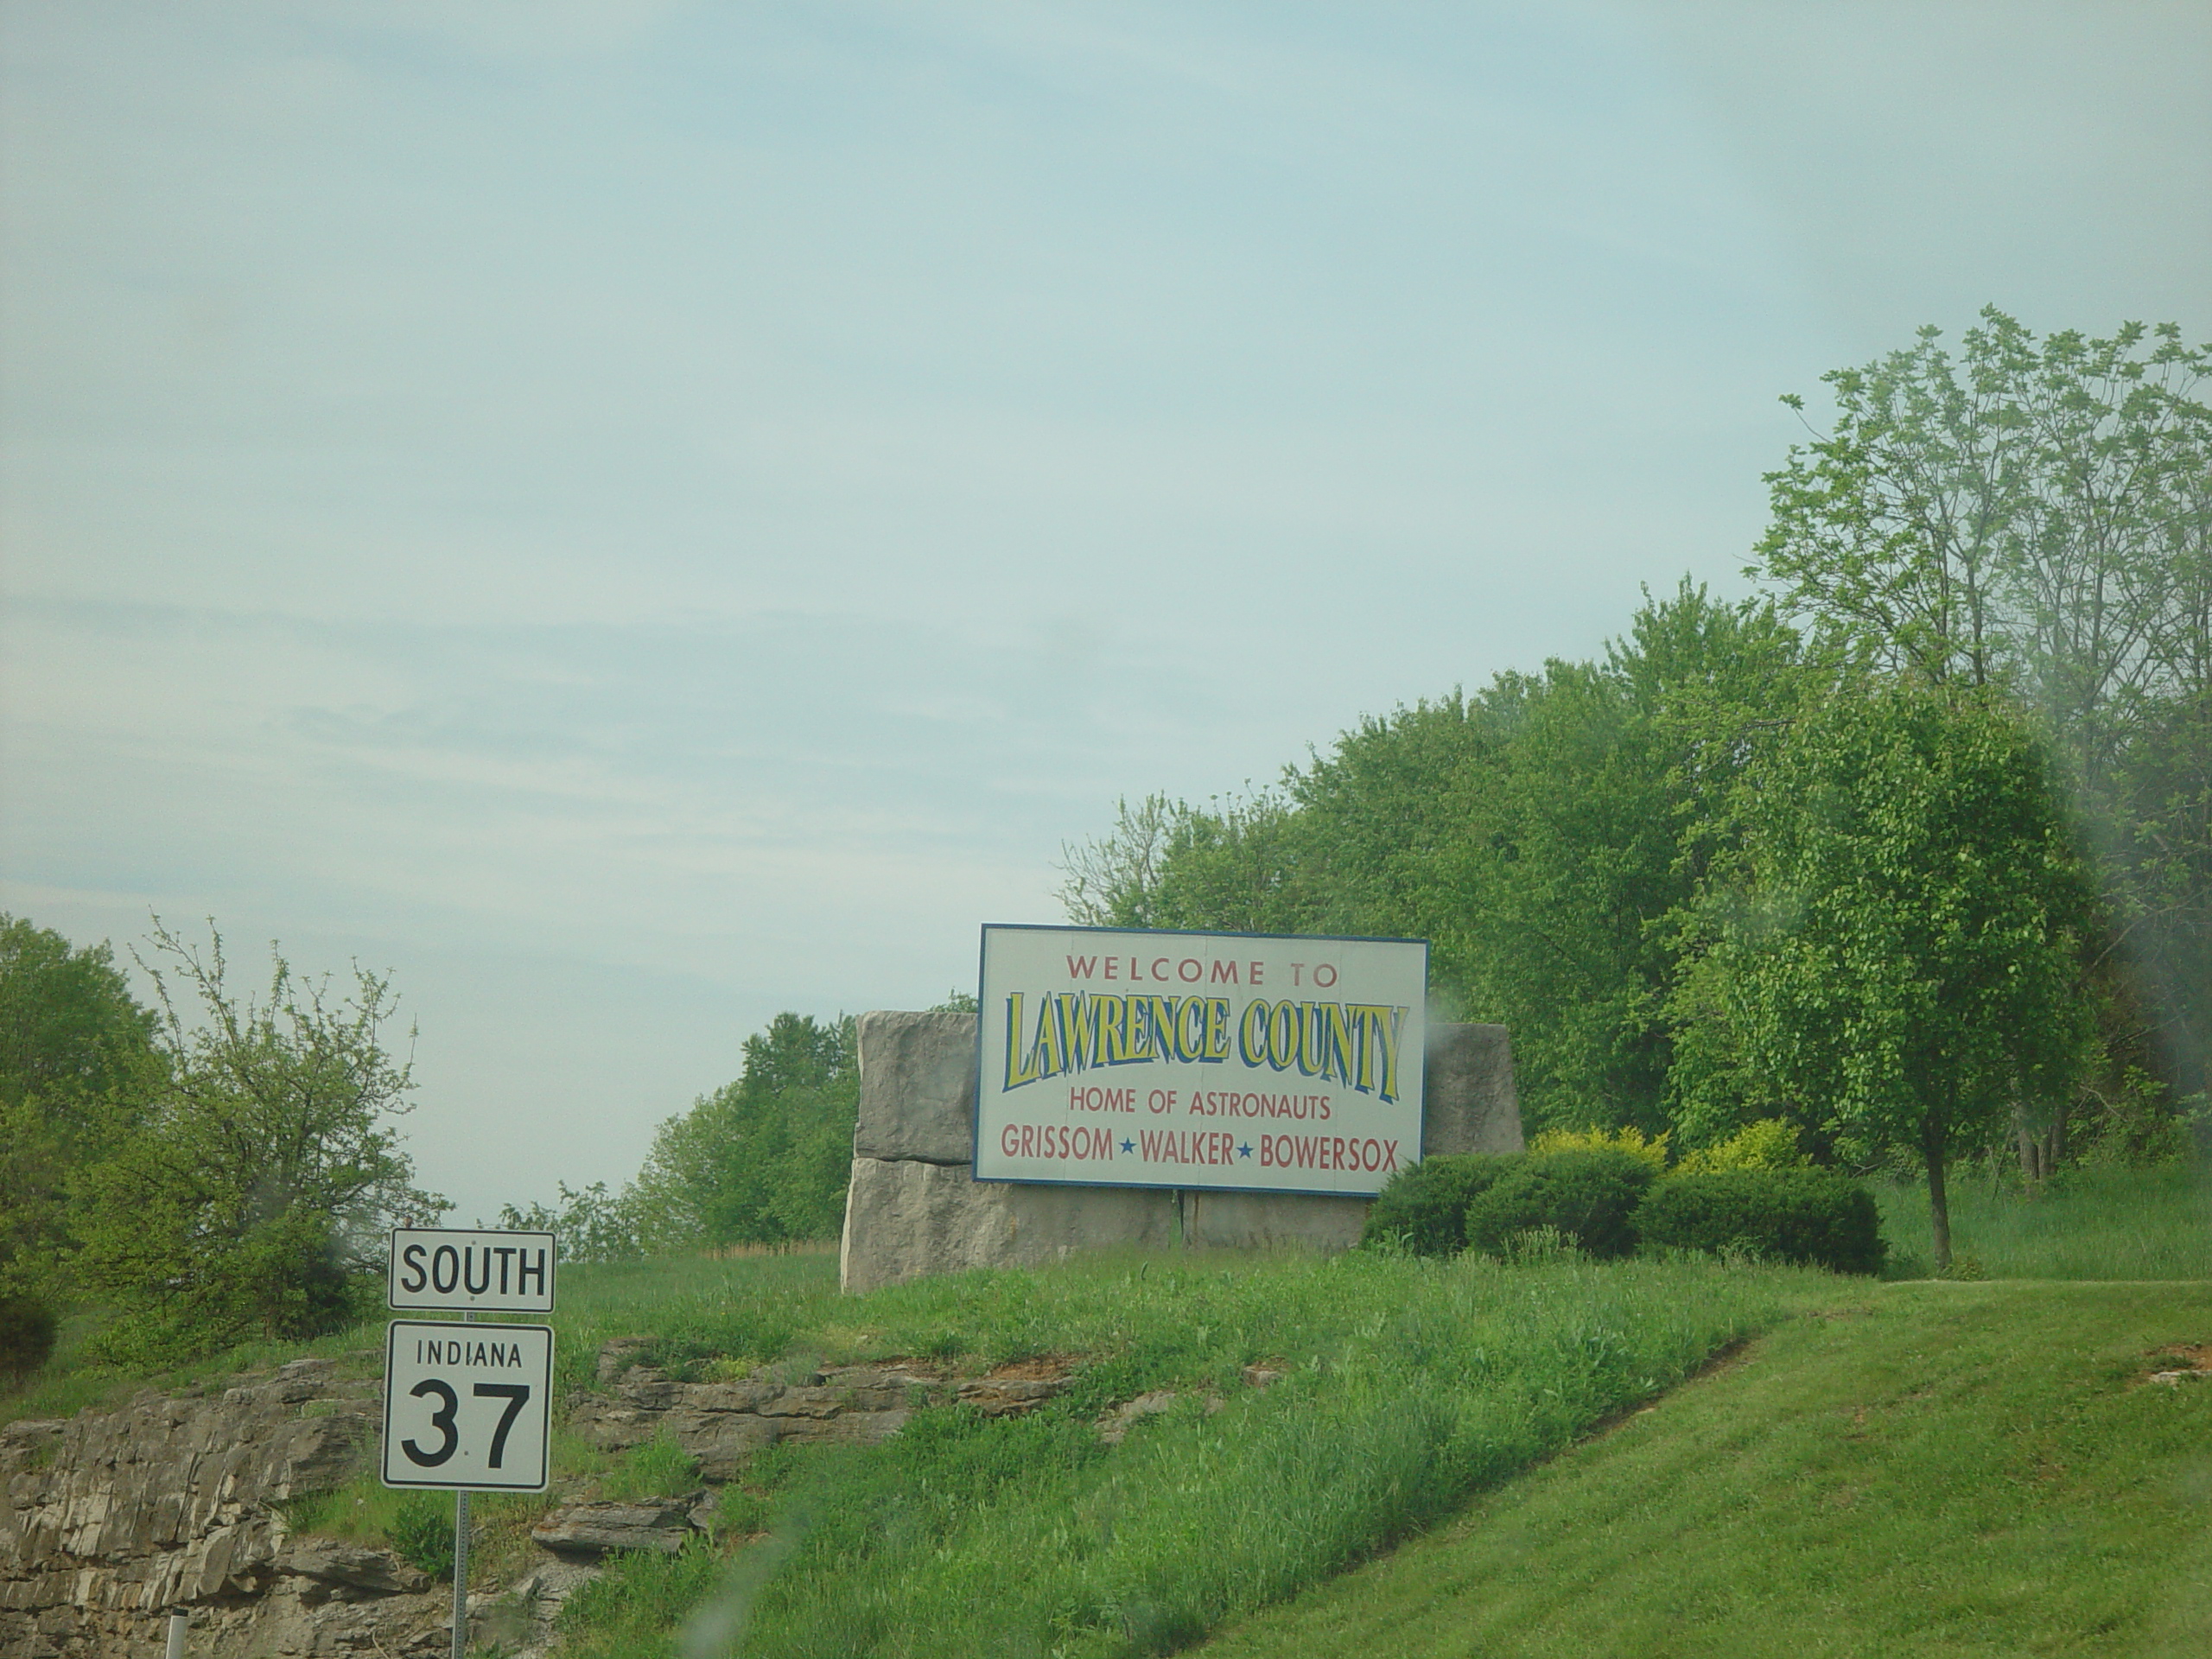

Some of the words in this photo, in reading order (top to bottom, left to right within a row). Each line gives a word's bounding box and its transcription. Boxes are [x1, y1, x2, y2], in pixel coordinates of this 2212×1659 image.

[1066, 955, 1264, 985] WELCOME
[1291, 963, 1338, 988] TO
[1002, 989, 1231, 1093] LAWRENCE
[1239, 998, 1410, 1105] COUNTY
[1070, 1087, 1135, 1113] HOME
[1148, 1090, 1177, 1115] OF
[1189, 1091, 1331, 1120] ASTRONAUTS
[1001, 1123, 1113, 1160] GRISSOM
[1140, 1129, 1234, 1166] WALKER
[1261, 1135, 1398, 1173] BOWERSOX
[401, 1244, 545, 1296] SOUTH
[416, 1339, 522, 1368] INDIANA
[401, 1378, 530, 1469] 37
